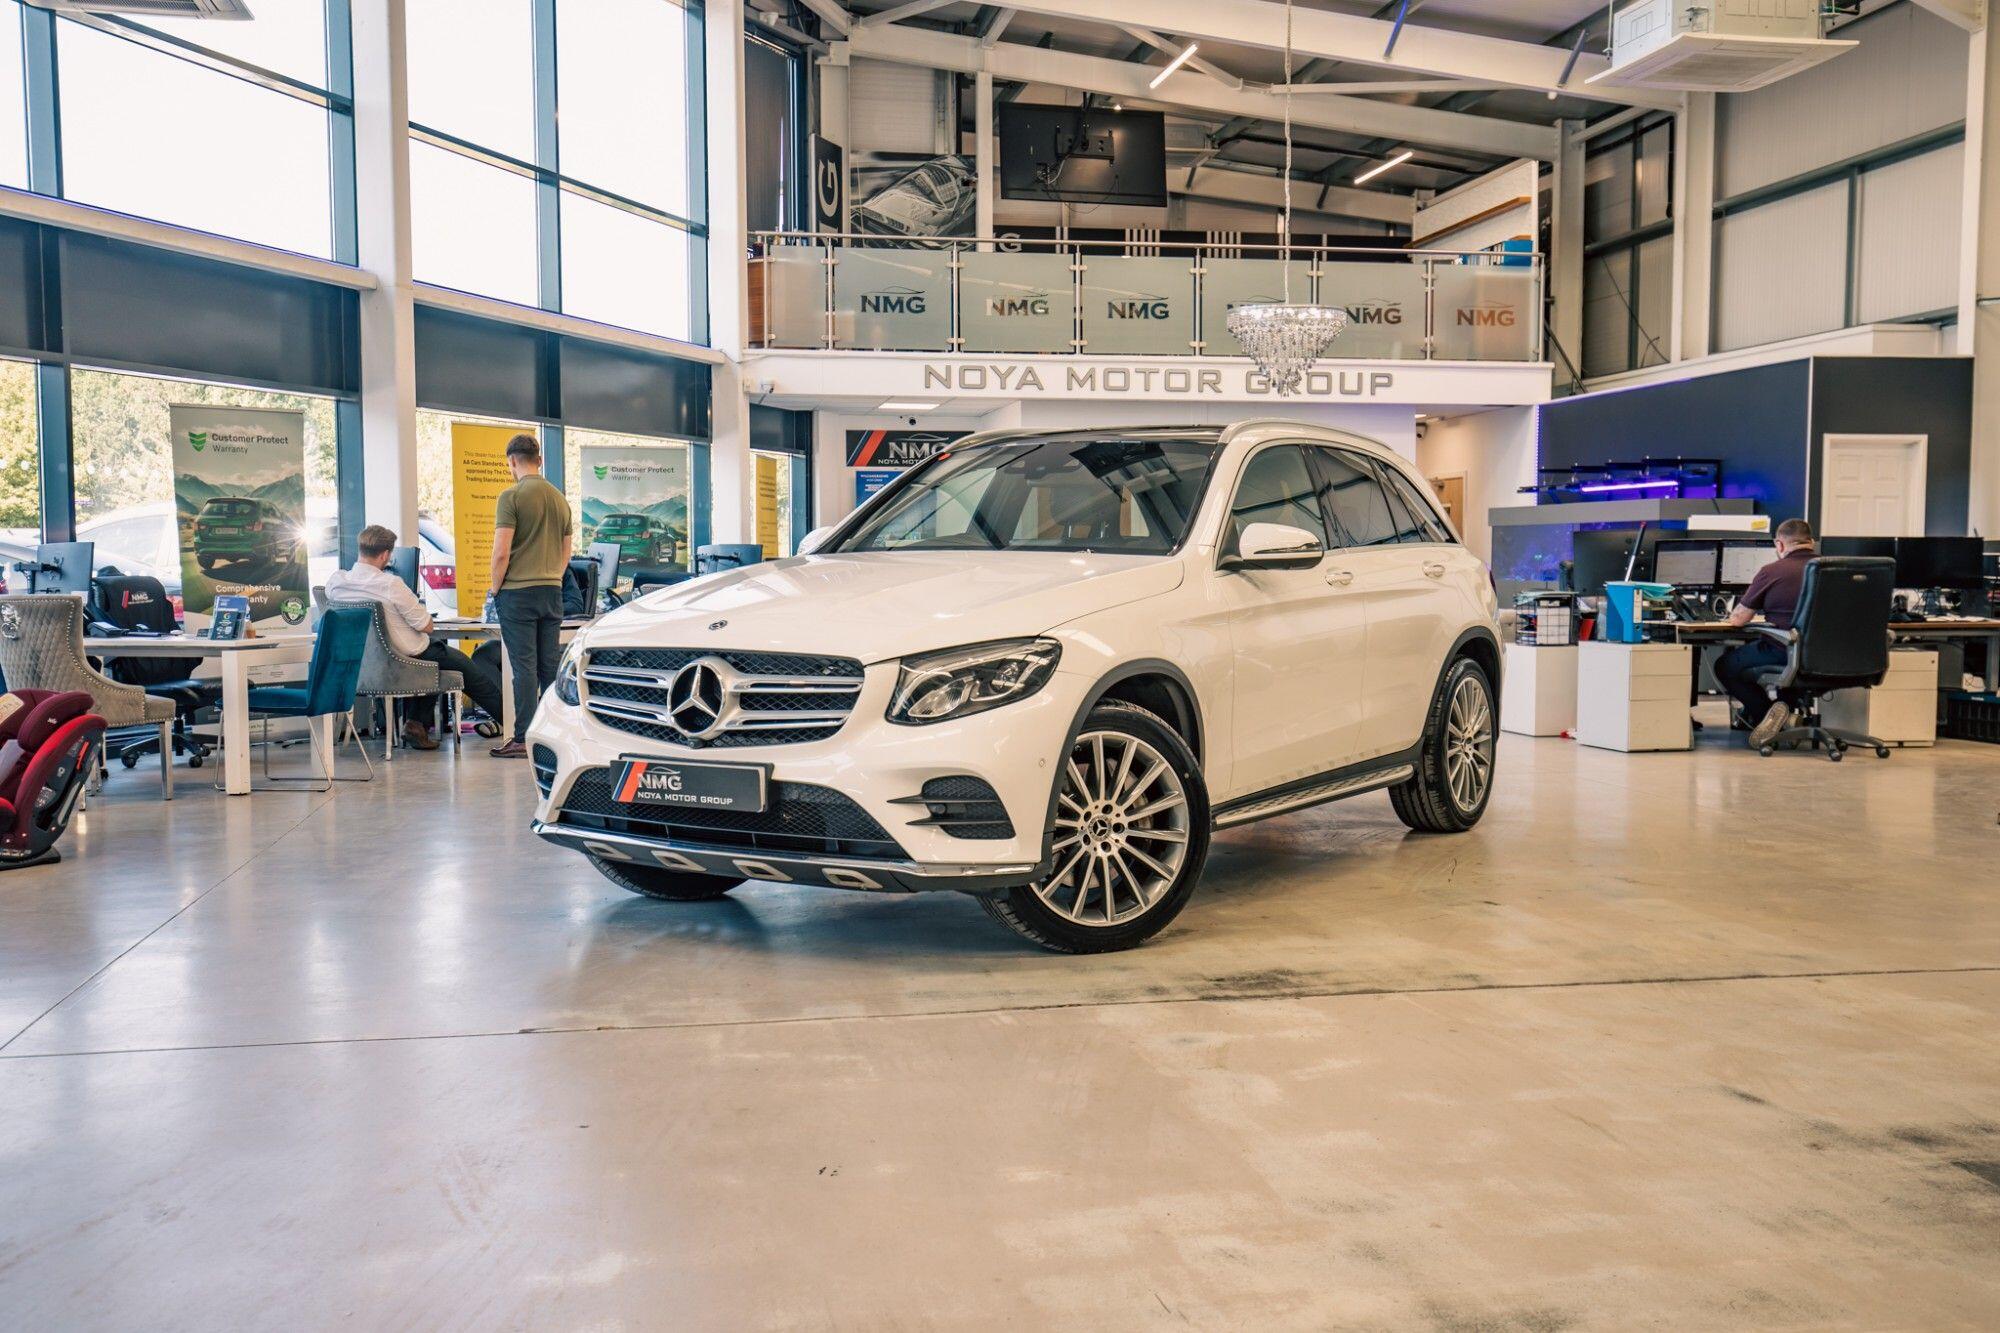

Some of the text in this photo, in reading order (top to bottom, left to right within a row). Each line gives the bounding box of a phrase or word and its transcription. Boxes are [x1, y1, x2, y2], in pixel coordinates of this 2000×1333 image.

[860, 295, 926, 314] NMG
[985, 298, 1050, 317] NMG
[1107, 301, 1170, 319] NMG
[1345, 307, 1402, 325] NMG
[1457, 309, 1515, 326] NMG
[924, 364, 1045, 391] NOYA
[1066, 366, 1223, 394] MOTOR
[211, 432, 288, 445] Customer Protect
[212, 444, 248, 455] Warranty
[611, 466, 675, 474] Customer Protect
[611, 474, 641, 482] Warranty
[215, 583, 282, 595] Comprehensive
[249, 595, 268, 604] anty
[637, 773, 682, 791] NMG
[637, 791, 733, 805] NOYA MOTOR GROUP
